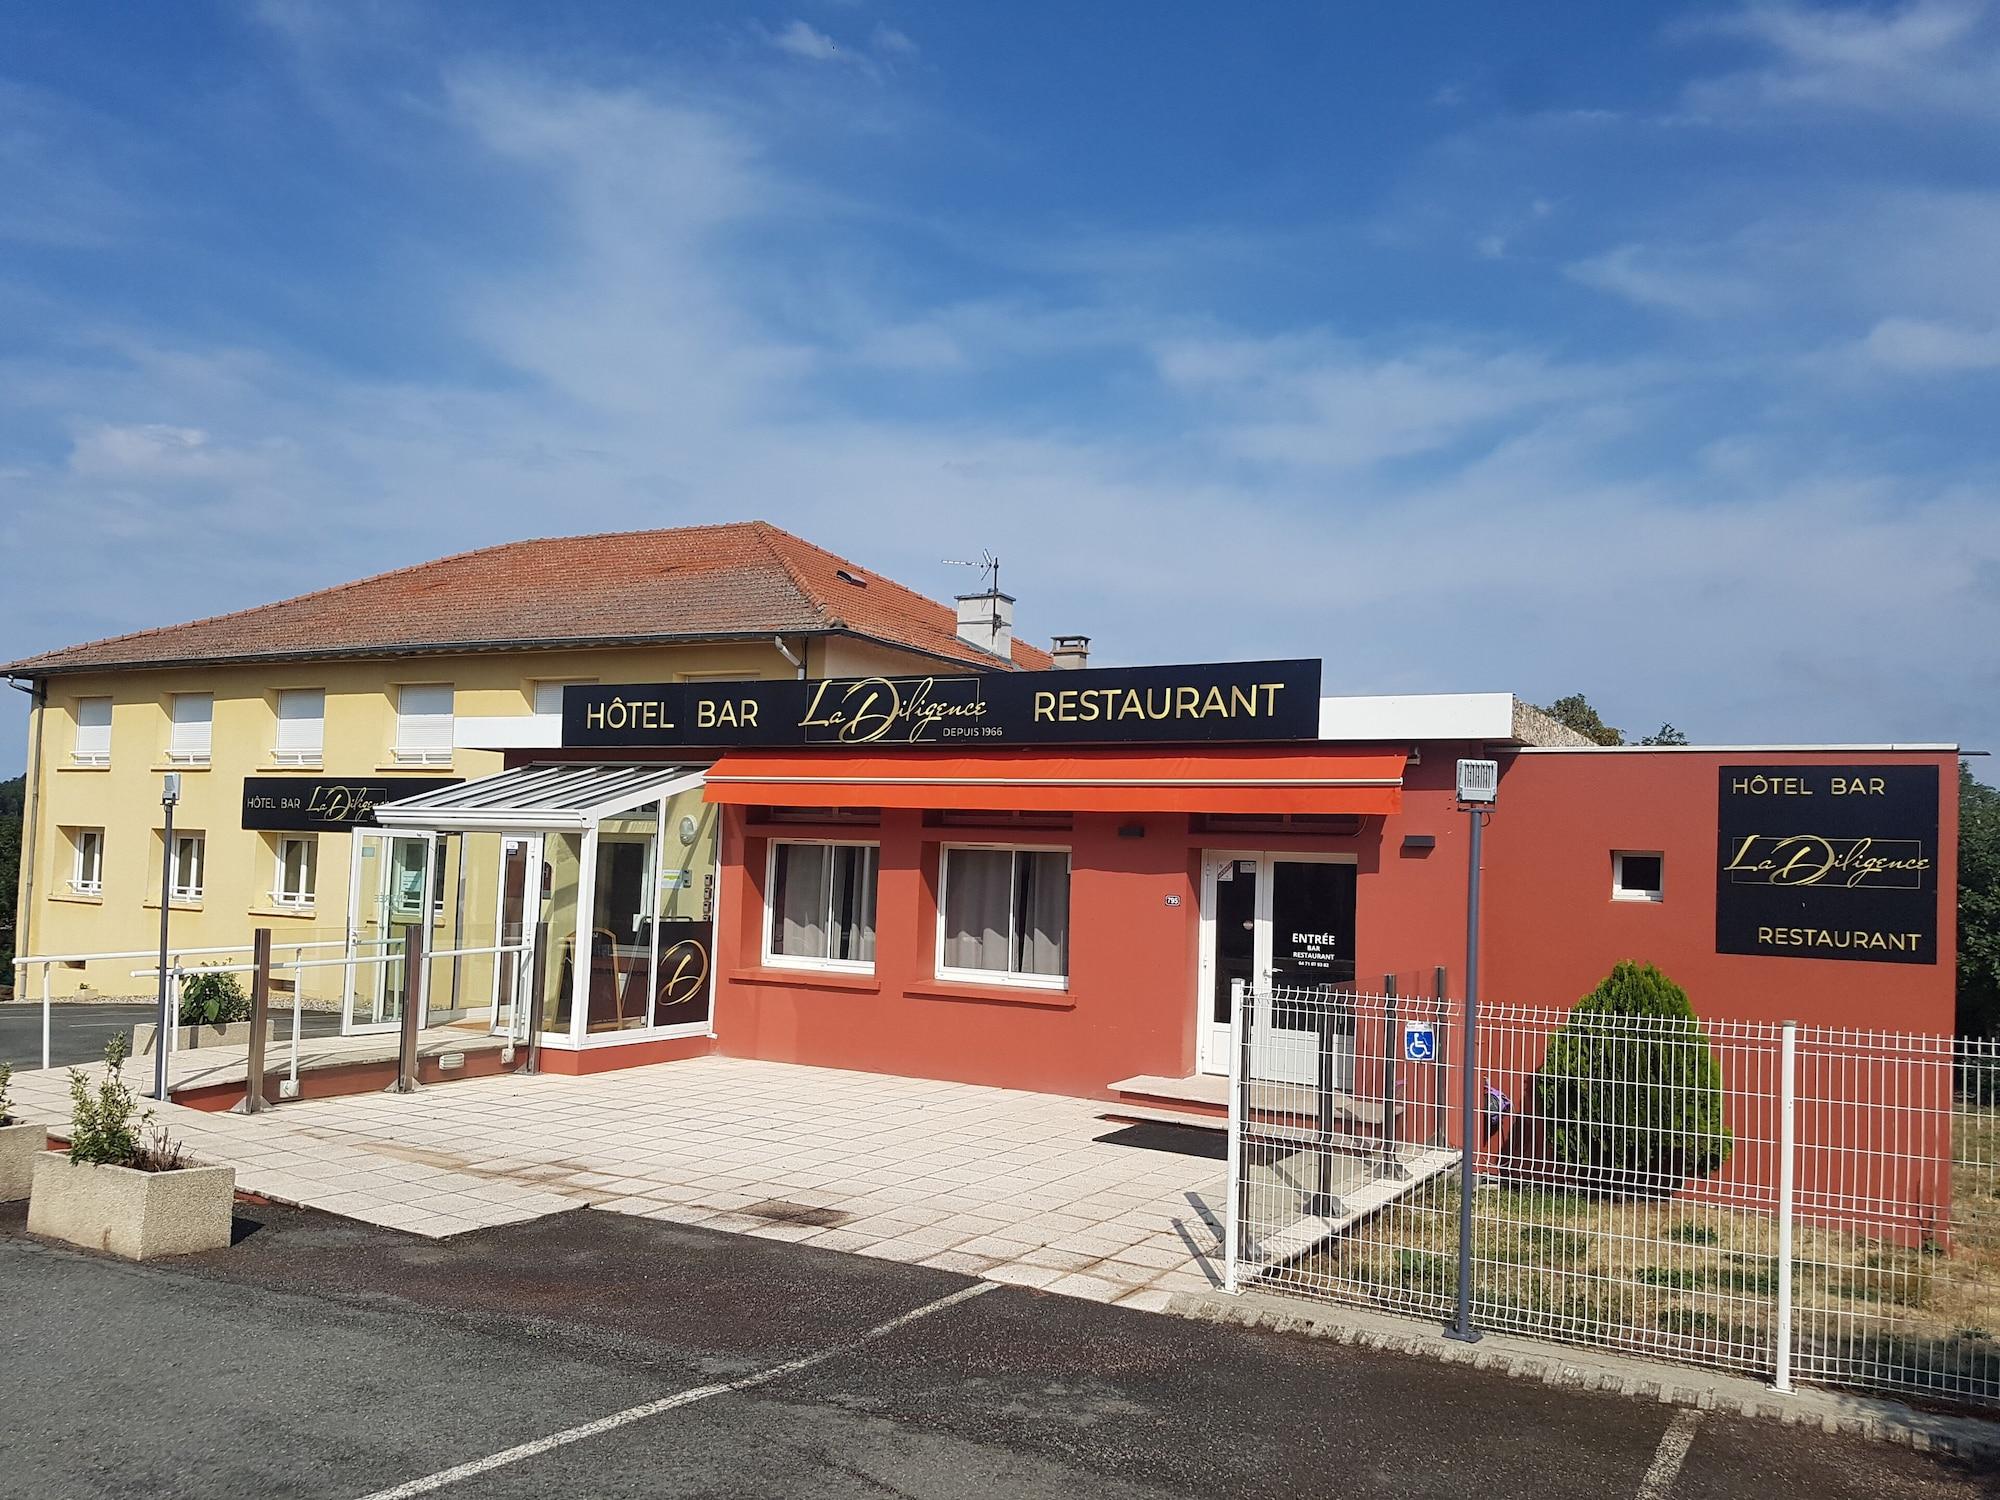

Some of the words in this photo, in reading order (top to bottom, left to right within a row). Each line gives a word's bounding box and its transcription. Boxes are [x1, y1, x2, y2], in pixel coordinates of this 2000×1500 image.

[587, 696, 674, 729] HÔTEL
[697, 700, 758, 728] BAR
[798, 679, 846, 727] La
[838, 677, 987, 743] Diligence
[1034, 683, 1285, 722] RESTAURANT
[942, 727, 979, 737] DEPUIS
[981, 726, 1003, 736] 1966
[1732, 774, 1813, 795] HÔTEL
[1831, 778, 1885, 795] BAR
[247, 795, 276, 809] HÔTEL
[281, 798, 300, 809] BAR
[1723, 835, 1777, 872] La
[1769, 834, 1930, 888] Diligence
[1292, 932, 1335, 945] ENTRÉE
[1758, 926, 1922, 951] RESTAURANT
[1293, 952, 1335, 960] RESTAURANT
